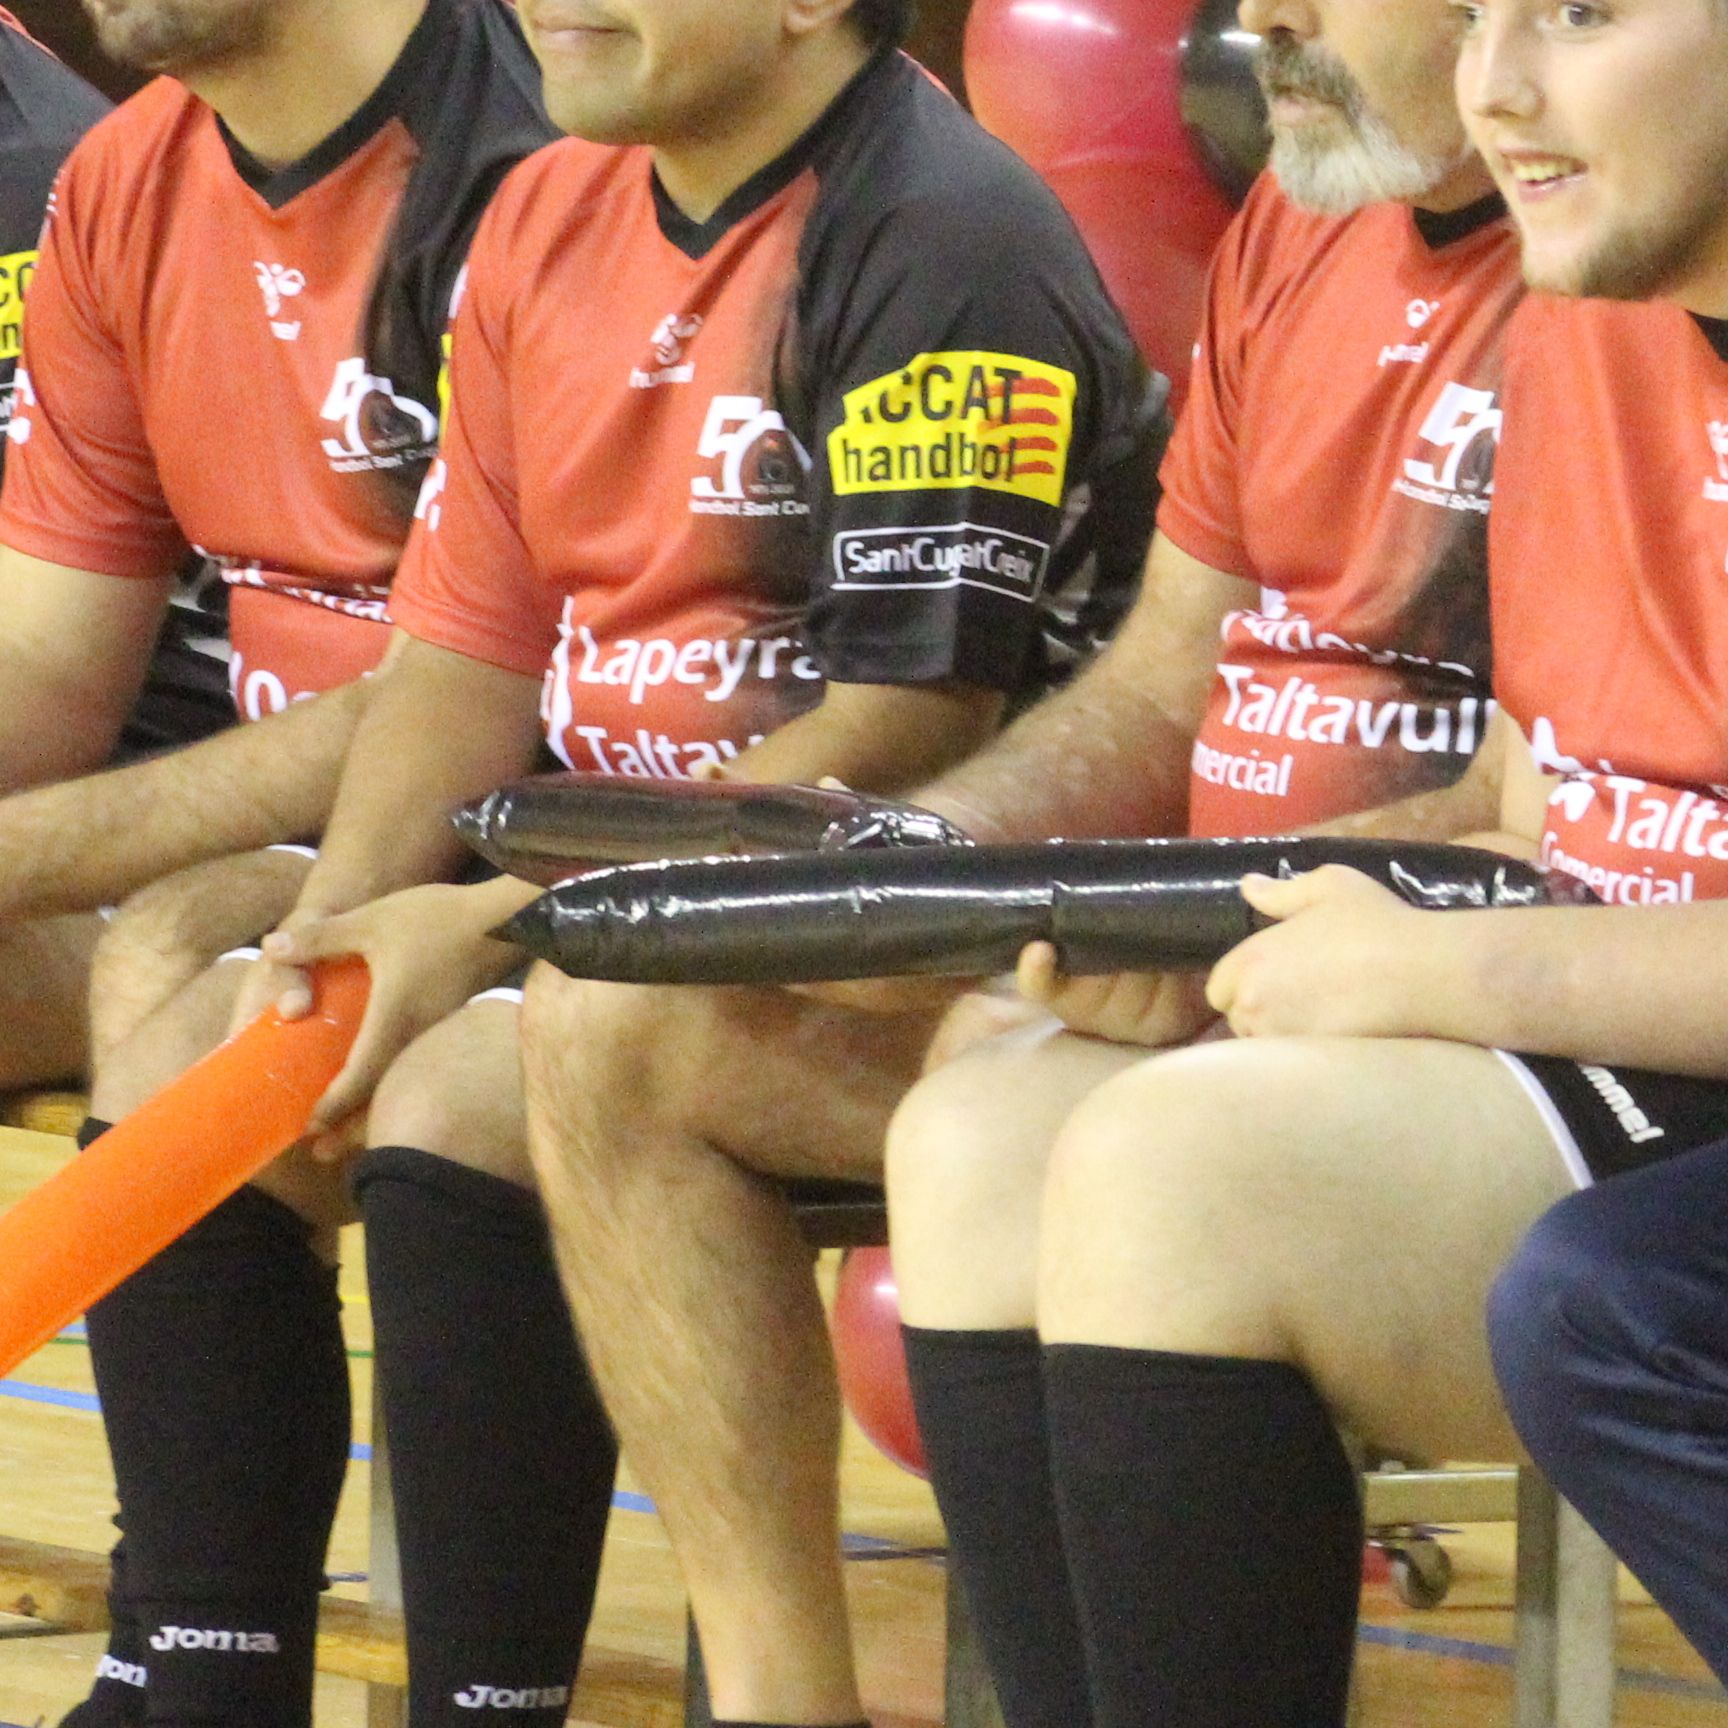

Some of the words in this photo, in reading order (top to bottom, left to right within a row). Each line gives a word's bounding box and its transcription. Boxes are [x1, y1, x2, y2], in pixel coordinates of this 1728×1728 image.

[860, 364, 1025, 425] CCAT
[842, 431, 1018, 483] handbol
[1191, 739, 1295, 798] mercial
[148, 1625, 282, 1654] Joma
